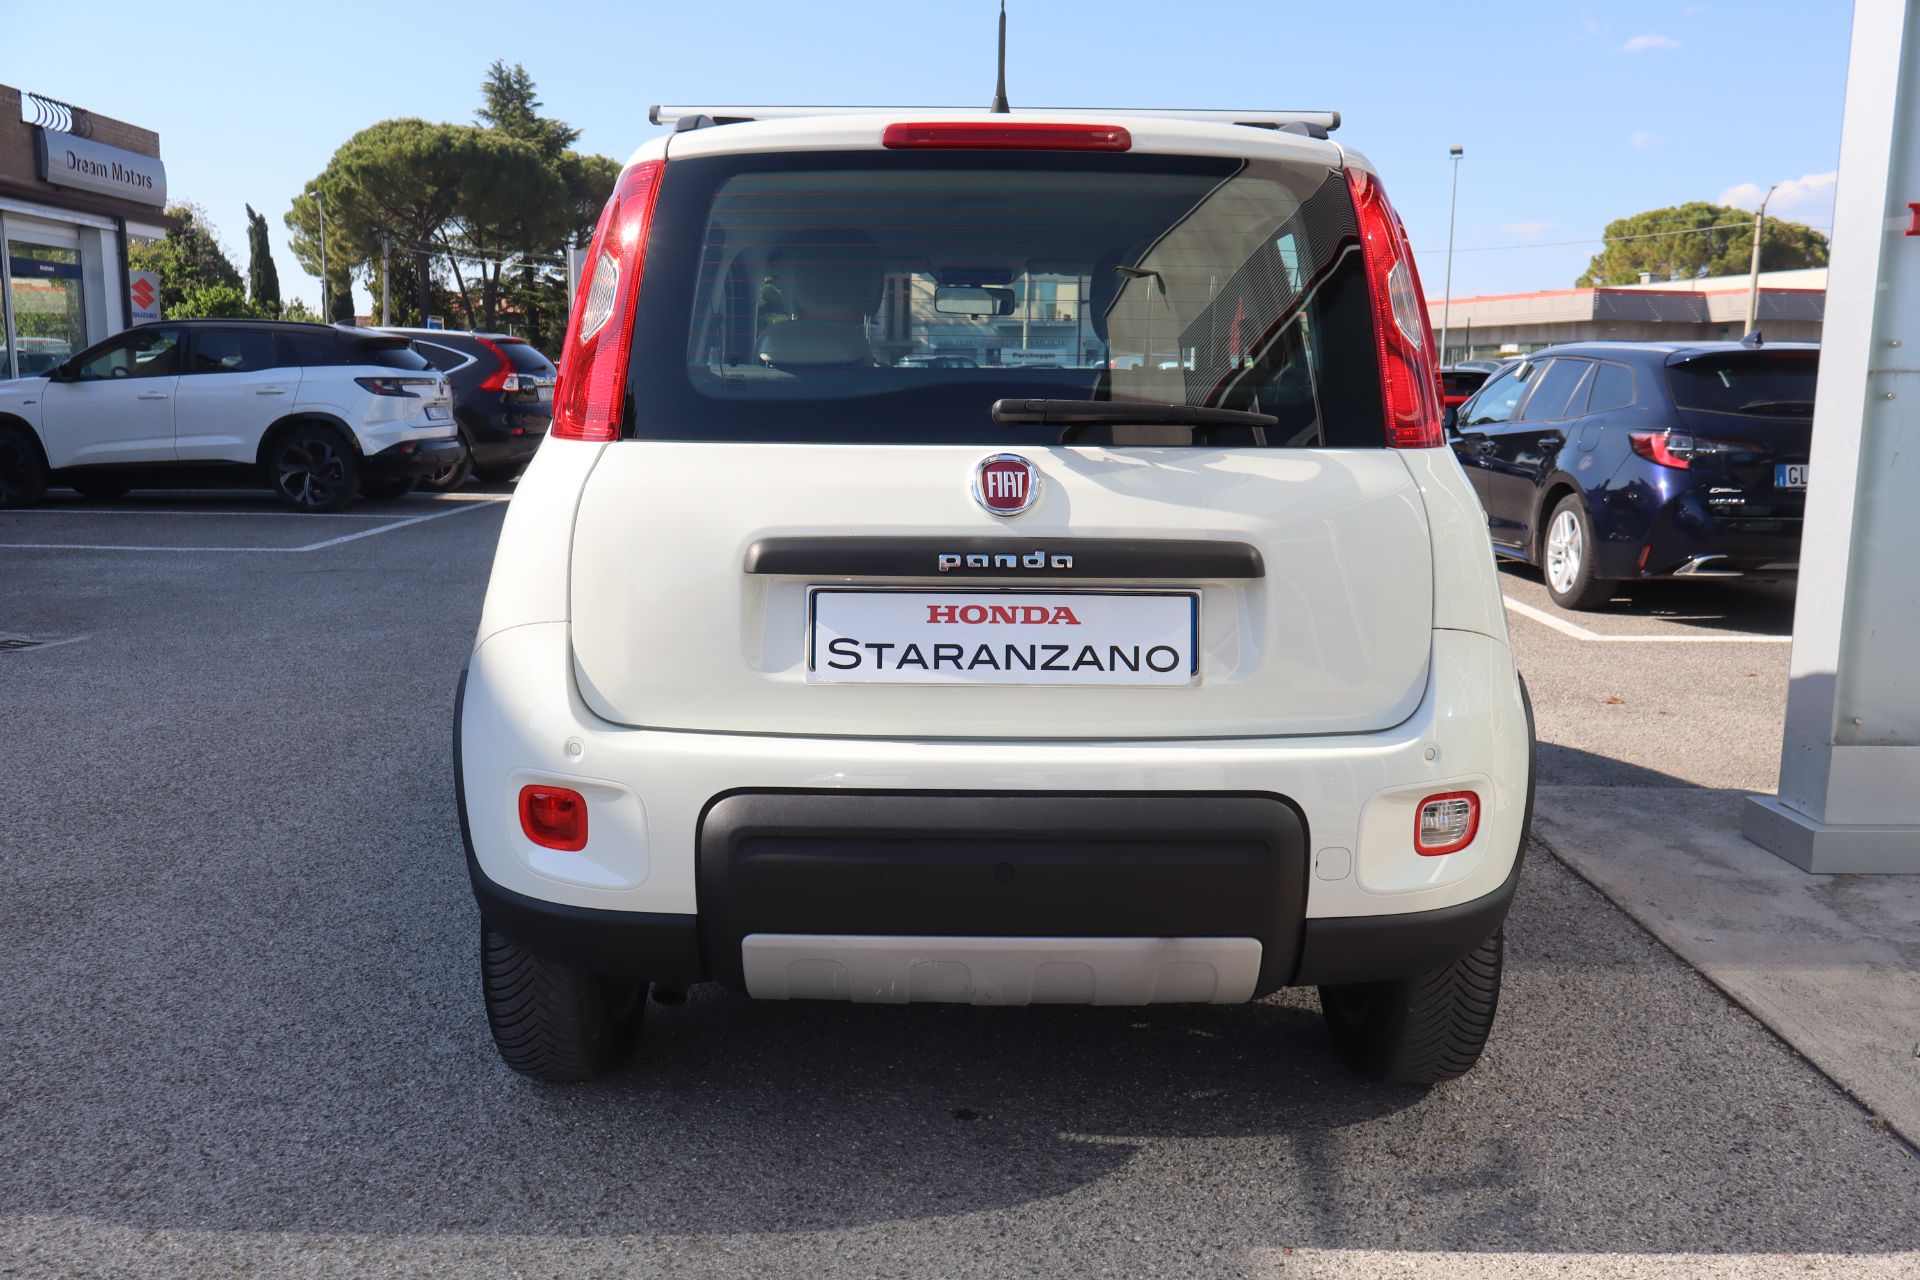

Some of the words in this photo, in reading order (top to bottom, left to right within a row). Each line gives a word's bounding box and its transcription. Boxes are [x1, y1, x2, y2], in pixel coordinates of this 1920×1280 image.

[67, 150, 107, 179] Dream
[112, 161, 153, 189] Motors
[987, 471, 1026, 498] FIAT
[938, 550, 1074, 572] panda
[926, 605, 1082, 625] HONDA
[827, 637, 1181, 673] STARANZANO
